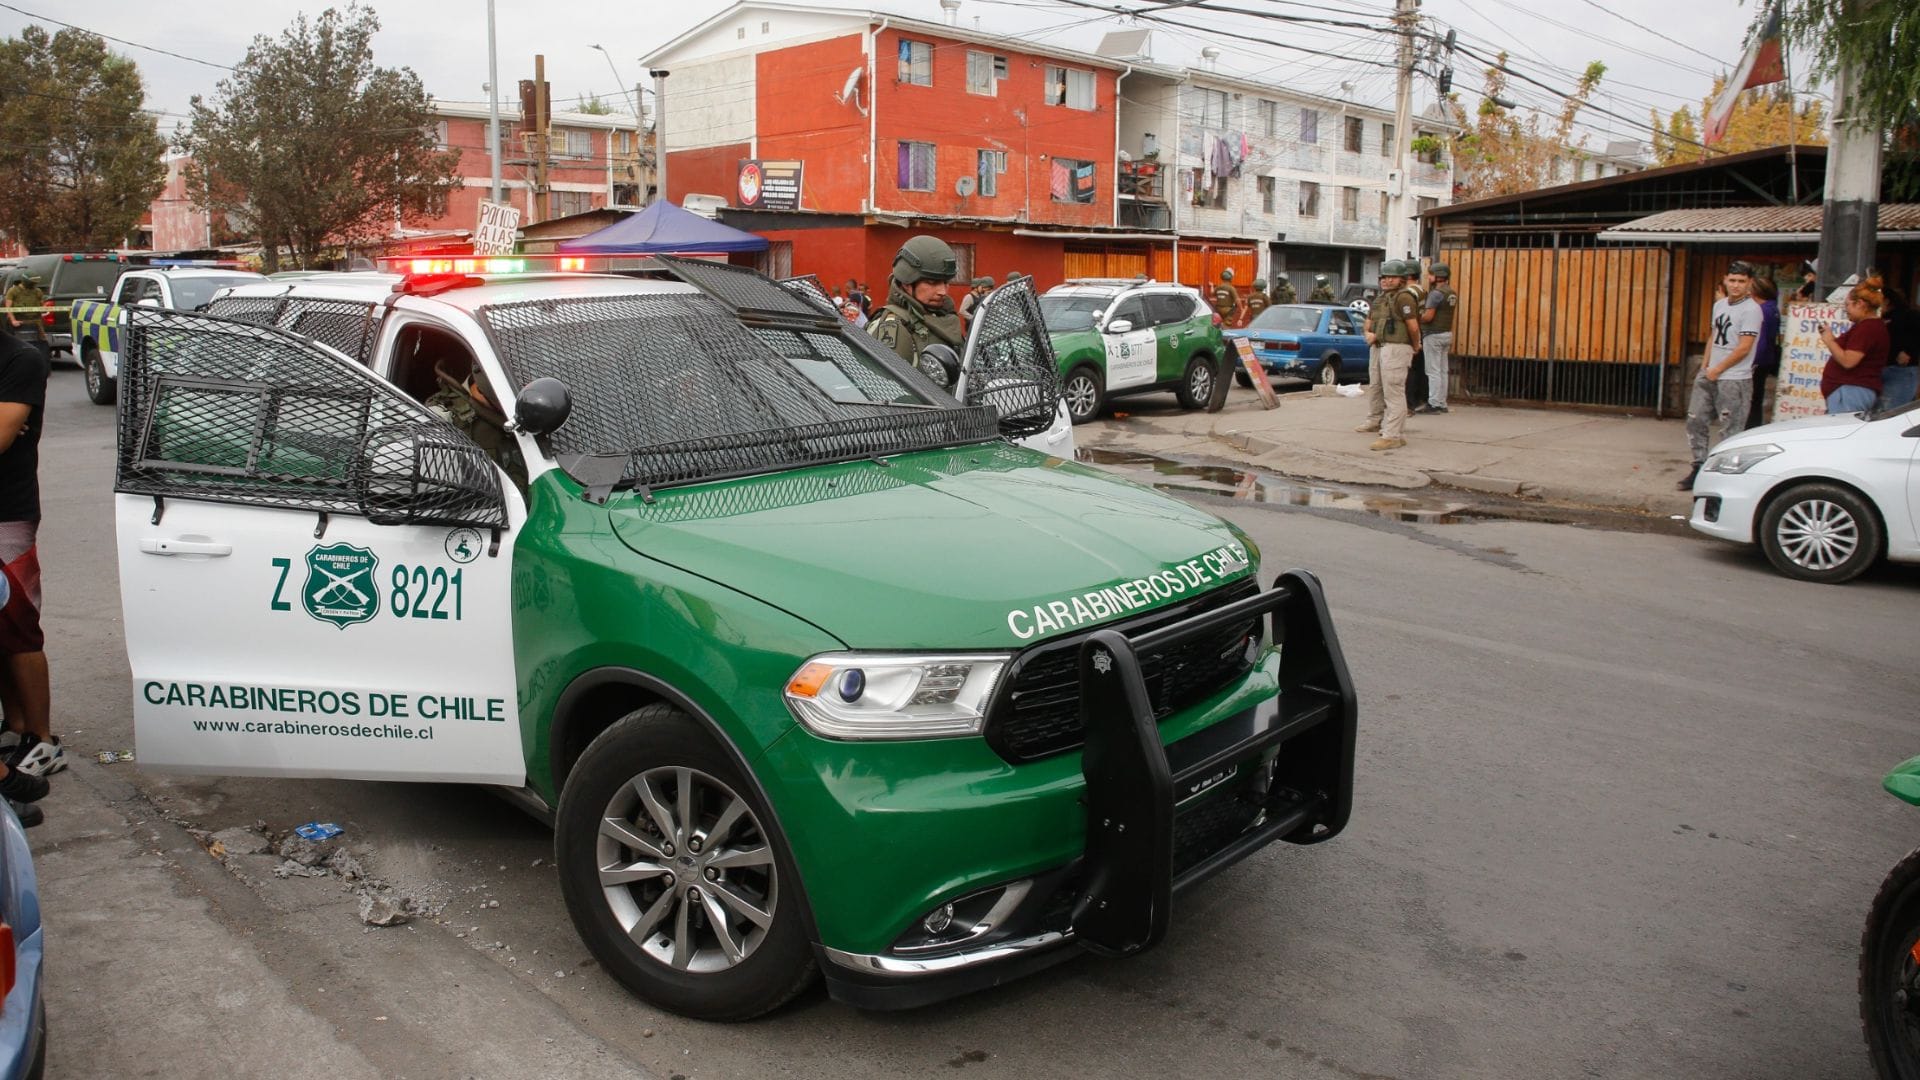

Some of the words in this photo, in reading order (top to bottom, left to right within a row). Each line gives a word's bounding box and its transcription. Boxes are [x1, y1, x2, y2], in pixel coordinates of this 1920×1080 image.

[479, 226, 488, 240] A
[492, 228, 514, 245] LAS
[1791, 306, 1837, 319] CIBER
[1788, 373, 1820, 388] Impr
[315, 554, 358, 563] CARABINEROS
[332, 562, 351, 570] CHILE
[271, 557, 291, 612] Z
[390, 564, 463, 621] 8221
[1007, 570, 1185, 639] CARABINEROS
[1176, 560, 1212, 588] DE
[1202, 543, 1249, 577] CHILE
[144, 681, 361, 716] CARABINEROS
[369, 693, 409, 717] DE
[417, 695, 505, 722] CHILE
[193, 720, 433, 740] www.carabinerosdechile.cl
